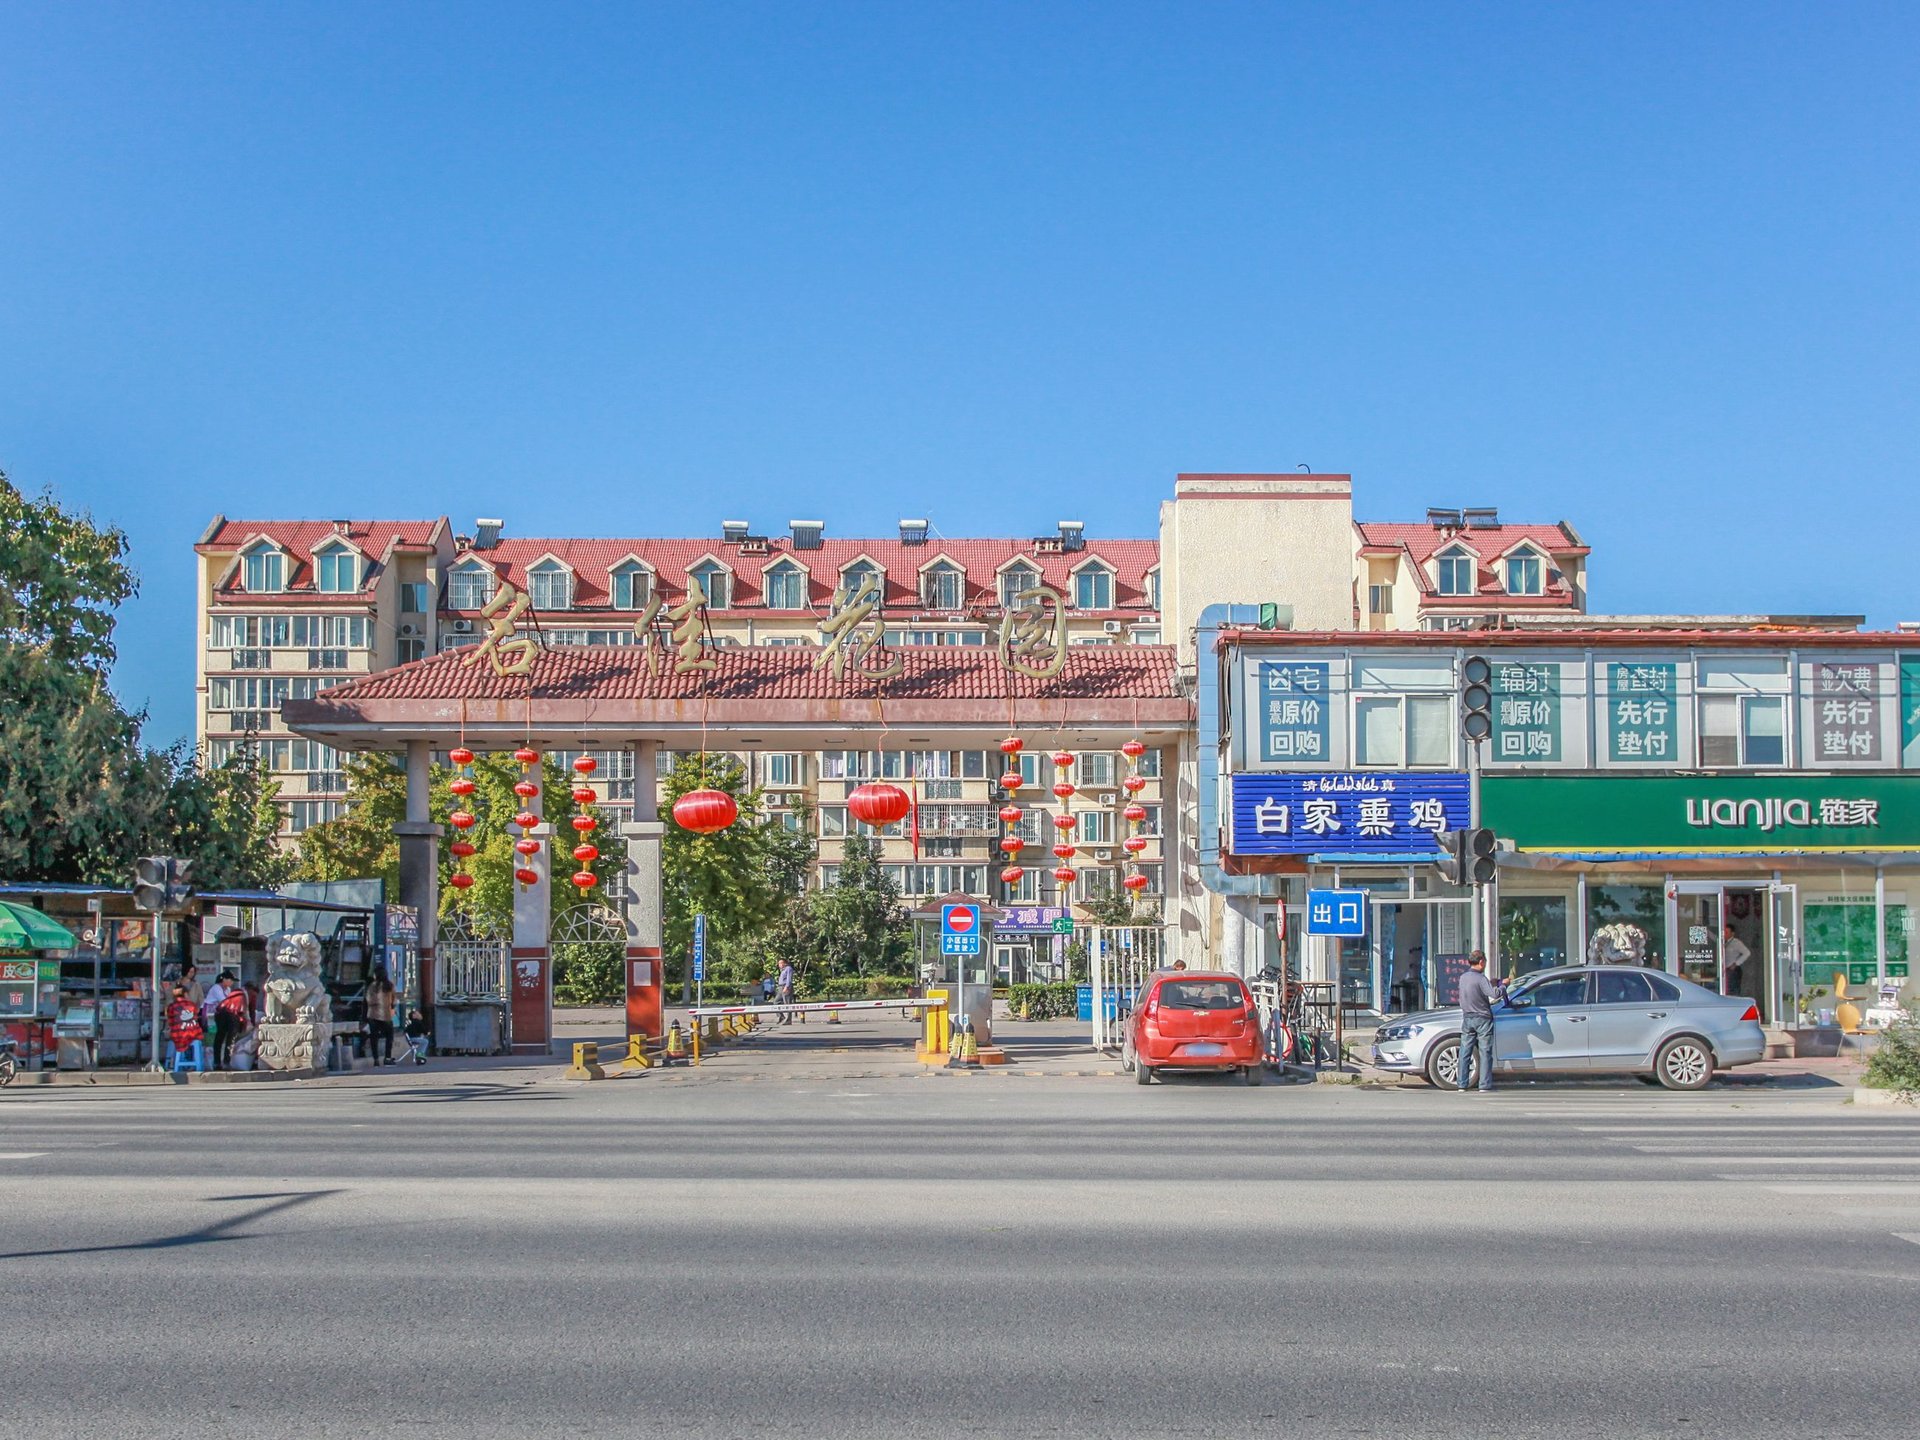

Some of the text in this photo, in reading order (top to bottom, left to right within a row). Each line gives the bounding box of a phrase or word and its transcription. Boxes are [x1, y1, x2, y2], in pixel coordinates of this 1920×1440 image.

[1269, 666, 1320, 692] 凶宅
[1500, 667, 1551, 692] 辐射
[1835, 667, 1872, 692] 欠费
[1282, 700, 1321, 726] 原价
[1513, 700, 1551, 726] 原价
[1617, 701, 1668, 726] 先行
[1823, 701, 1873, 726] 先行
[1269, 731, 1321, 756] 回购
[1501, 731, 1552, 756] 回购
[1618, 731, 1668, 756] 垫付
[1823, 731, 1873, 756] 垫付
[1255, 797, 1446, 836] 白家熏鸡
[1313, 903, 1358, 924] 出口
